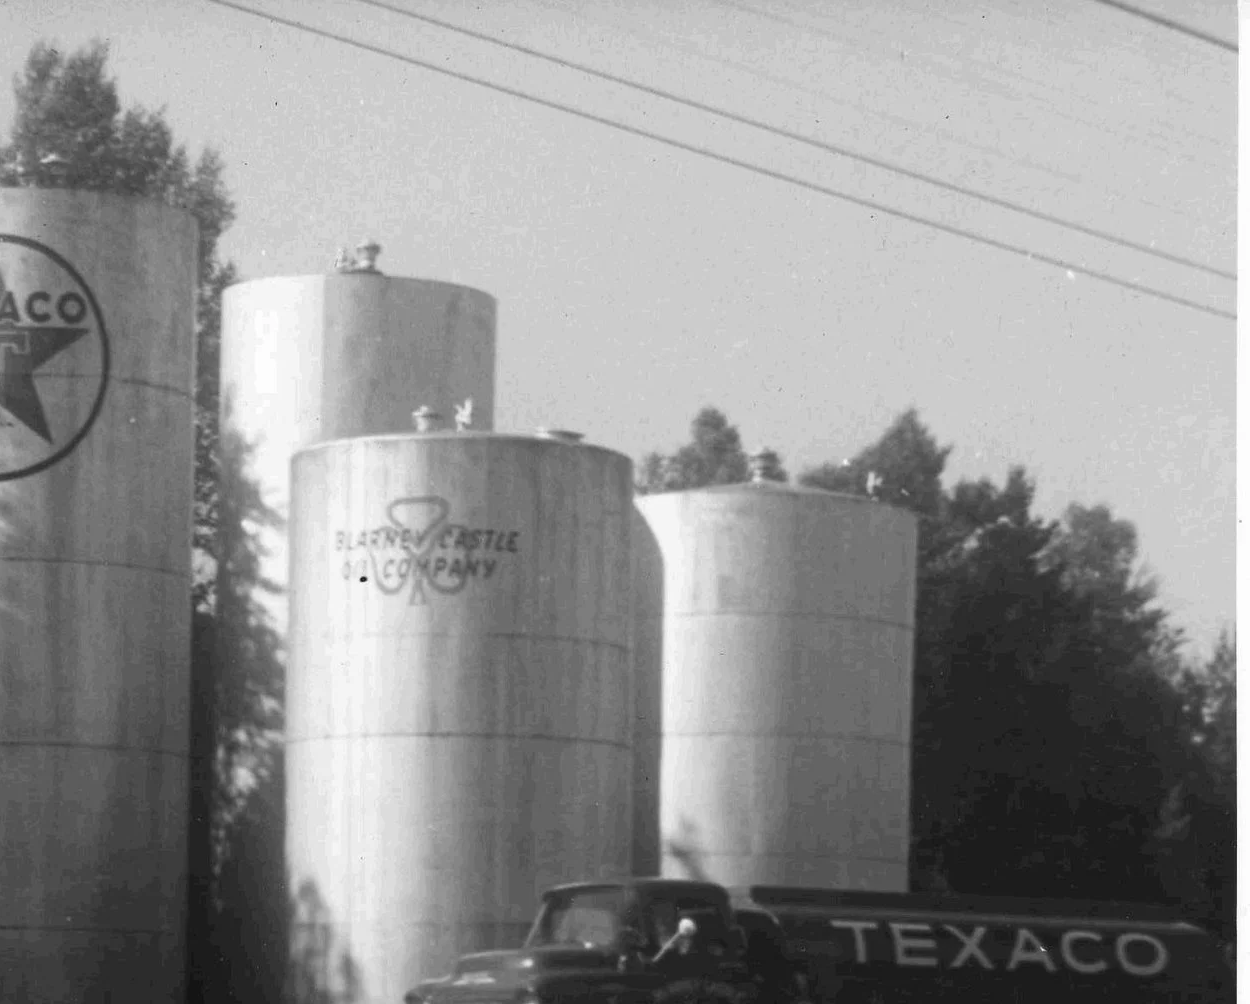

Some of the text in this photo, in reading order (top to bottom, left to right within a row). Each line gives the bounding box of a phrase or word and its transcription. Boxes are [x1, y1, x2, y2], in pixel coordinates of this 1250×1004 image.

[335, 528, 520, 552] BLARNEY CASTLE
[383, 558, 497, 579] COMPANY
[829, 918, 1169, 976] TEXACO
